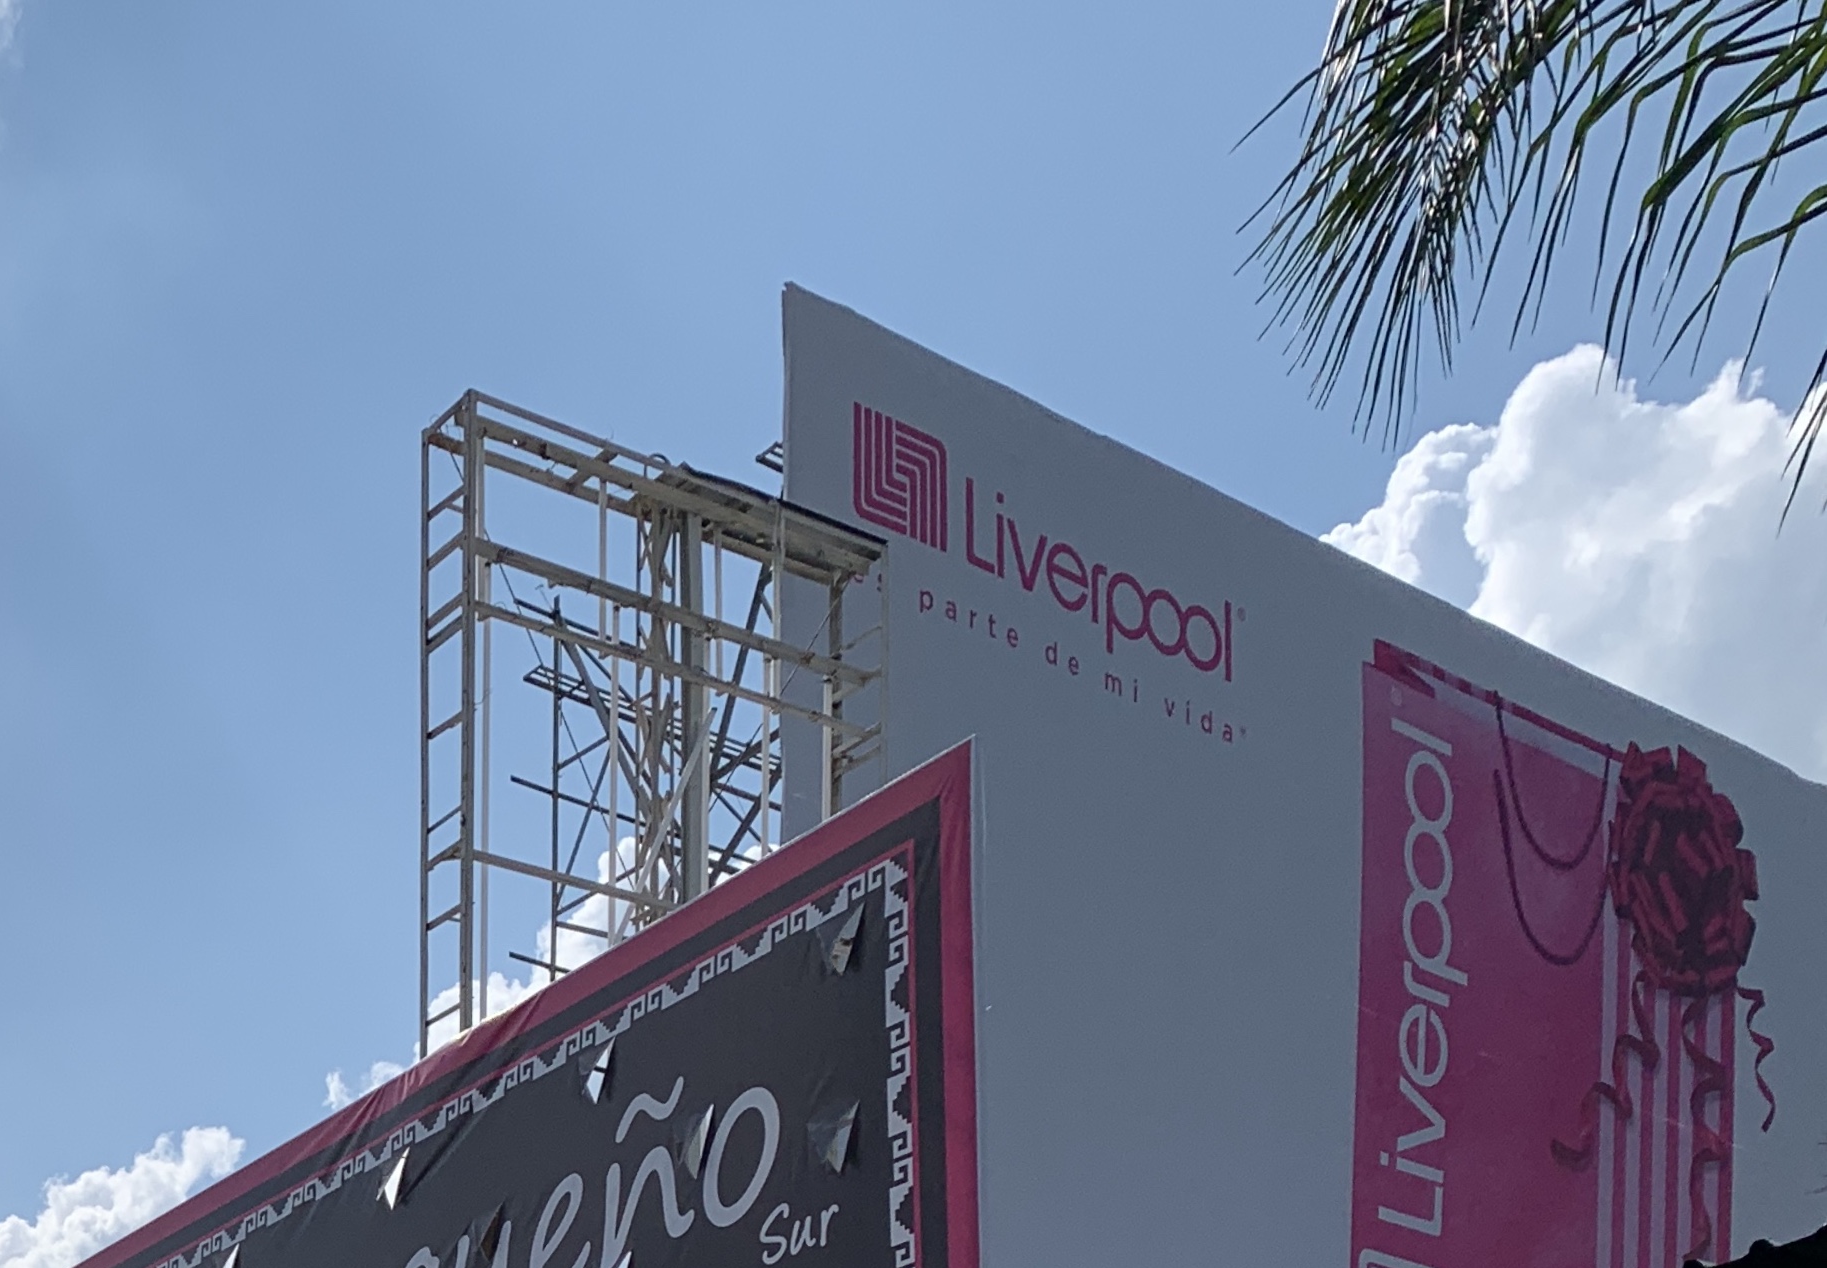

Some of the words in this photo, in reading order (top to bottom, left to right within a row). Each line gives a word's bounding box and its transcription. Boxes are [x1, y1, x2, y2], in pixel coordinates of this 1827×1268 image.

[919, 589, 1019, 649] parte
[1045, 641, 1080, 676] de
[1104, 671, 1139, 704] mi
[1164, 697, 1234, 744] vida
[965, 477, 1232, 683] Liverpool
[1378, 717, 1468, 1238] Liverpool
[759, 1202, 839, 1267] Sur
